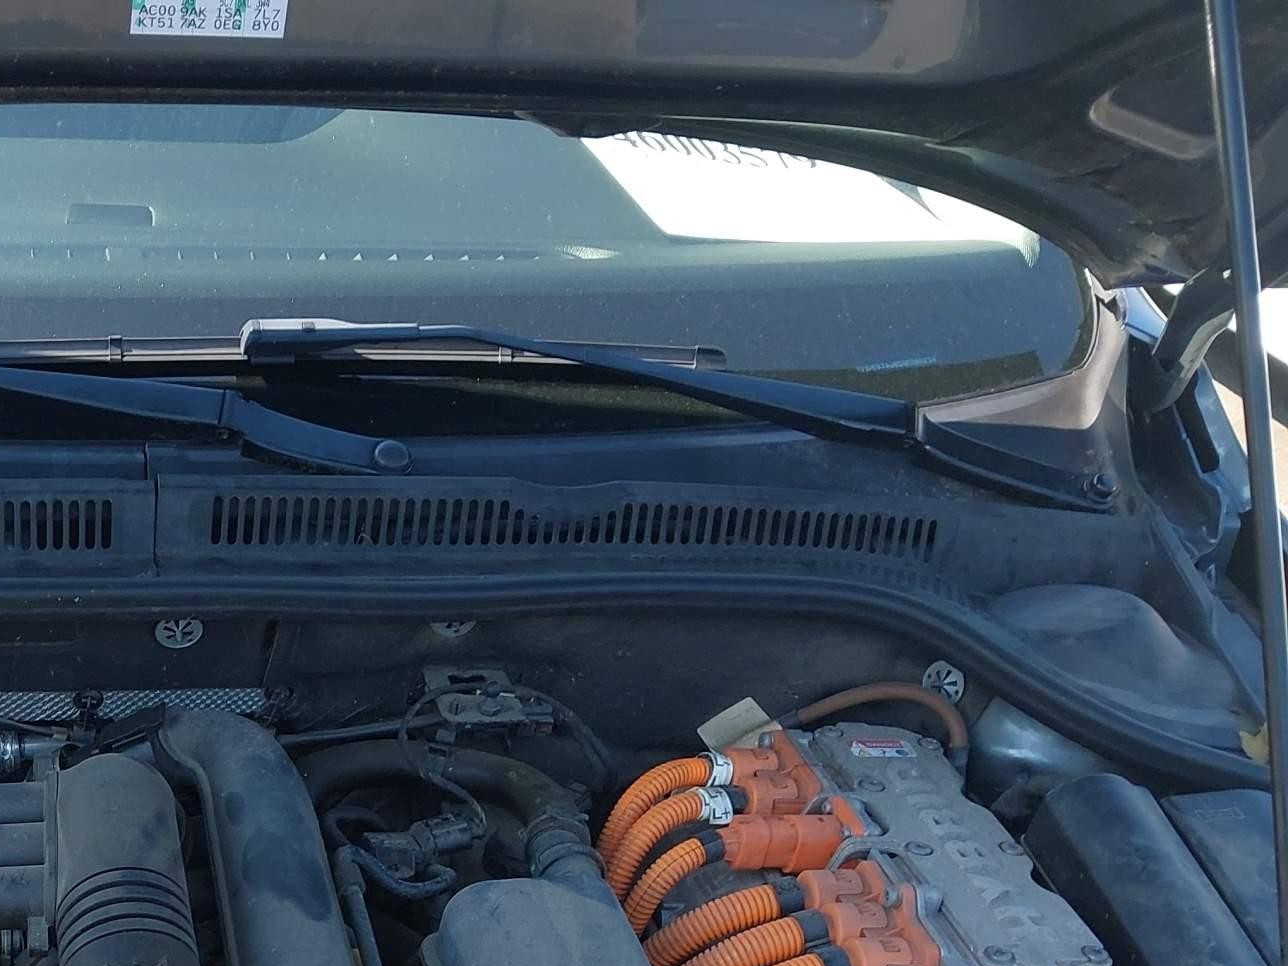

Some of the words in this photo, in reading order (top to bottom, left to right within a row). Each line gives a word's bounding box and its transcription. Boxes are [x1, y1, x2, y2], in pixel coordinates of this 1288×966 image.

[139, 4, 176, 16] AC00
[180, 6, 207, 17] 9AK
[216, 7, 242, 19] 1SA
[254, 9, 281, 20] 7L7
[138, 16, 174, 28] KT51
[180, 18, 206, 29] 7AZ
[252, 20, 280, 31] 8Y0
[713, 808, 731, 820] L+
